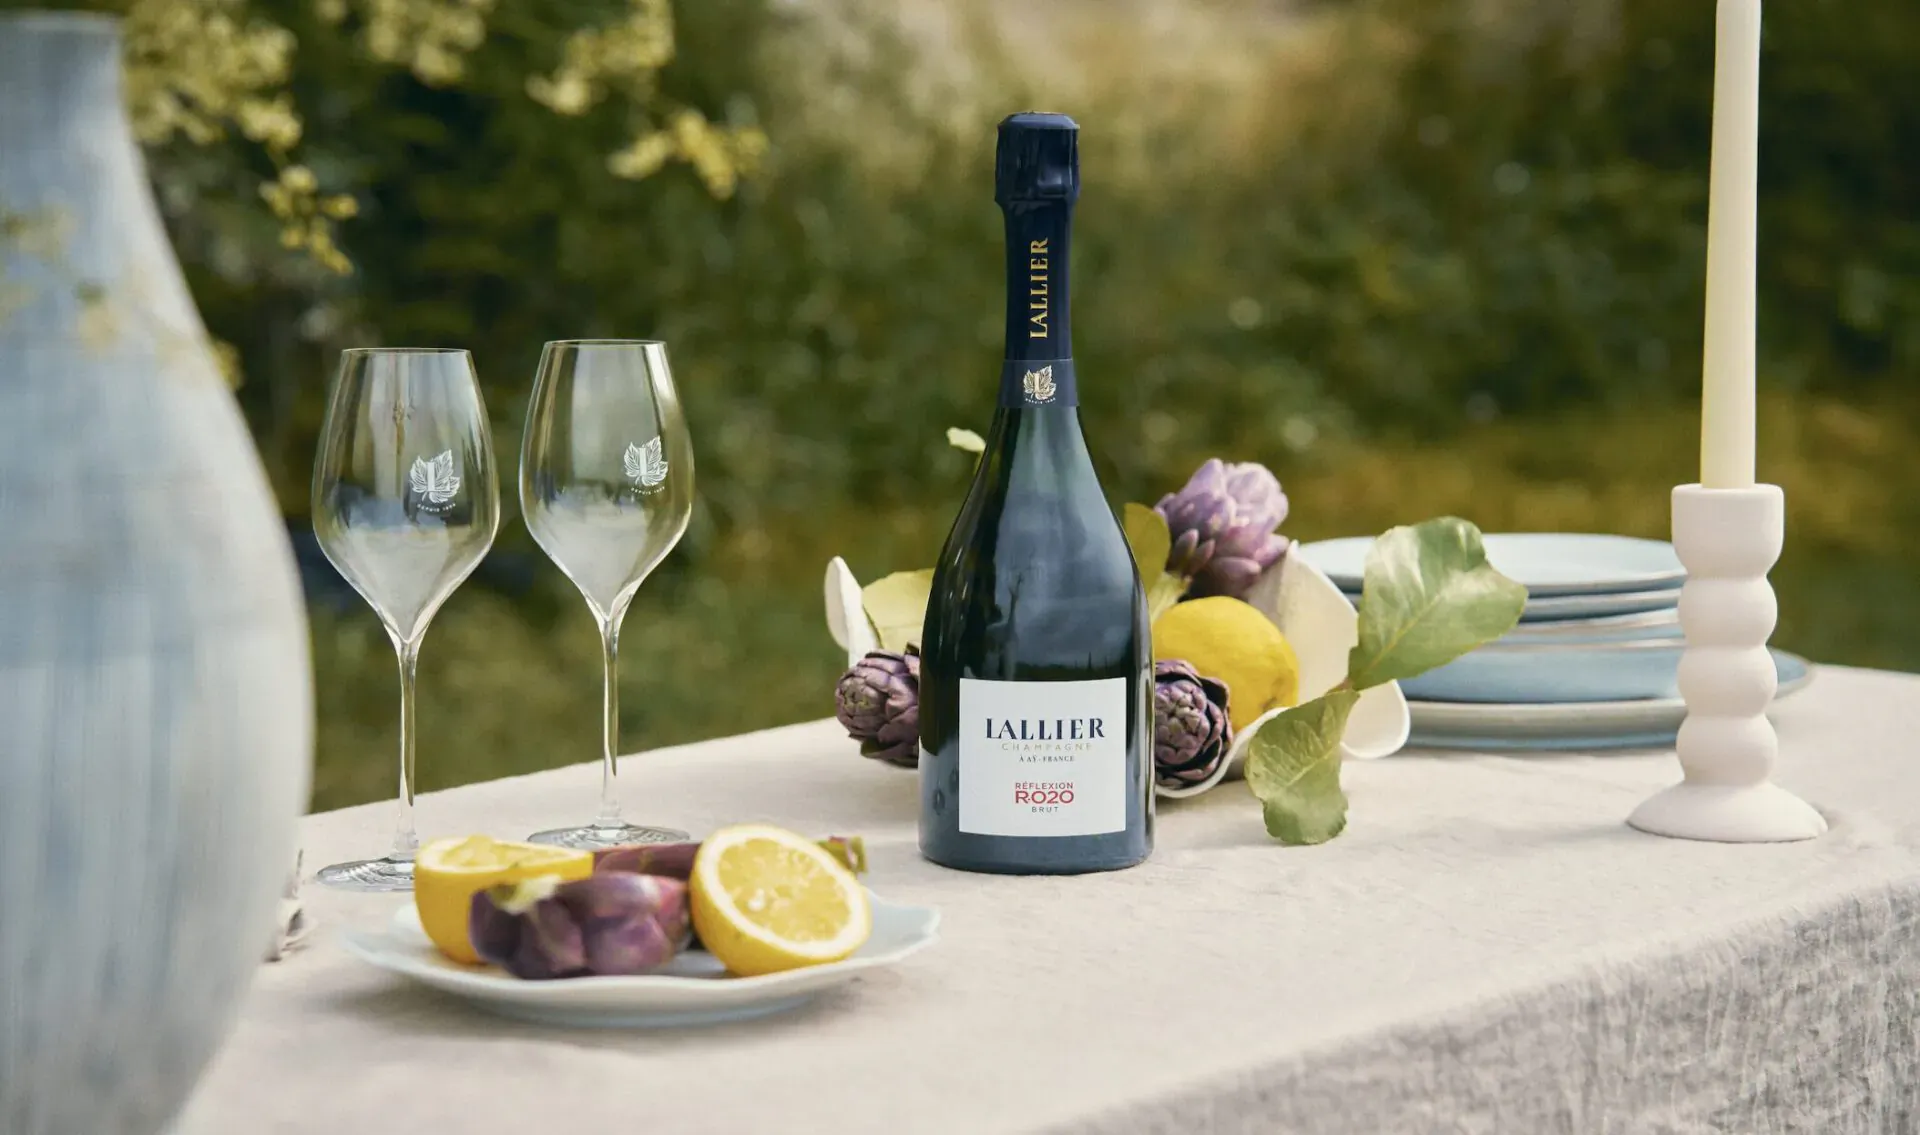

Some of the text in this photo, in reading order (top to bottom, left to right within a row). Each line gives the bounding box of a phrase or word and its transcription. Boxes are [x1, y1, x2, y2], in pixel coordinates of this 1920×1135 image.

[1030, 237, 1049, 339] LALLIER
[986, 717, 1105, 740] LALLIER
[1001, 742, 1093, 751] CHAMPAGNE
[1015, 781, 1073, 790] RÉFLEXION
